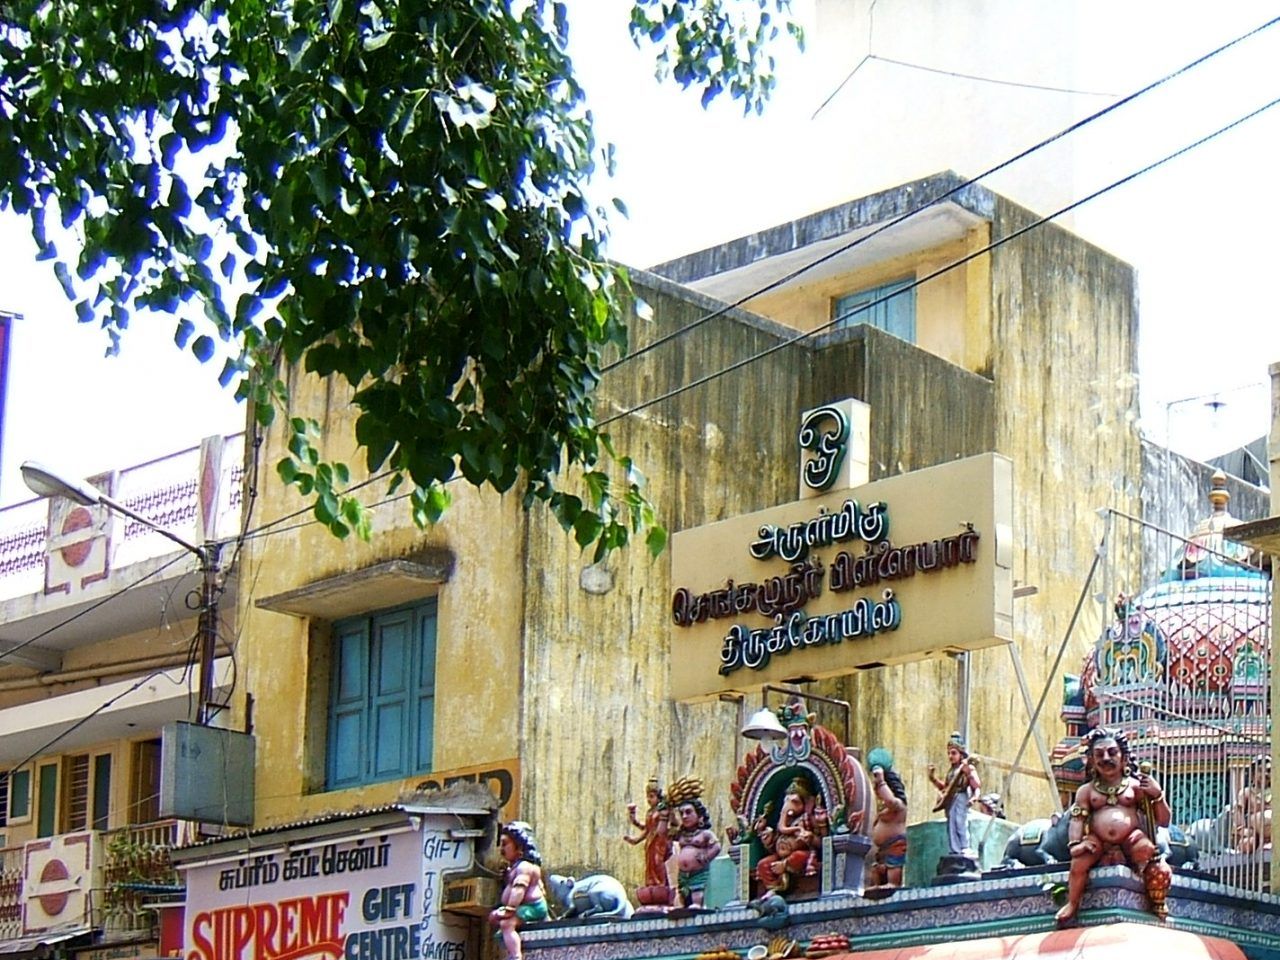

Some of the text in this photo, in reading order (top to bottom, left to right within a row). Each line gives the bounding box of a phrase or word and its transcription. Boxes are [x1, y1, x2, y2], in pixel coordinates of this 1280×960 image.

[749, 499, 888, 562] அருள்மிகு
[718, 588, 902, 676] திருக்கோயில்
[424, 836, 466, 860] GIFT
[362, 882, 416, 924] GIFT
[420, 872, 436, 930] TOYS
